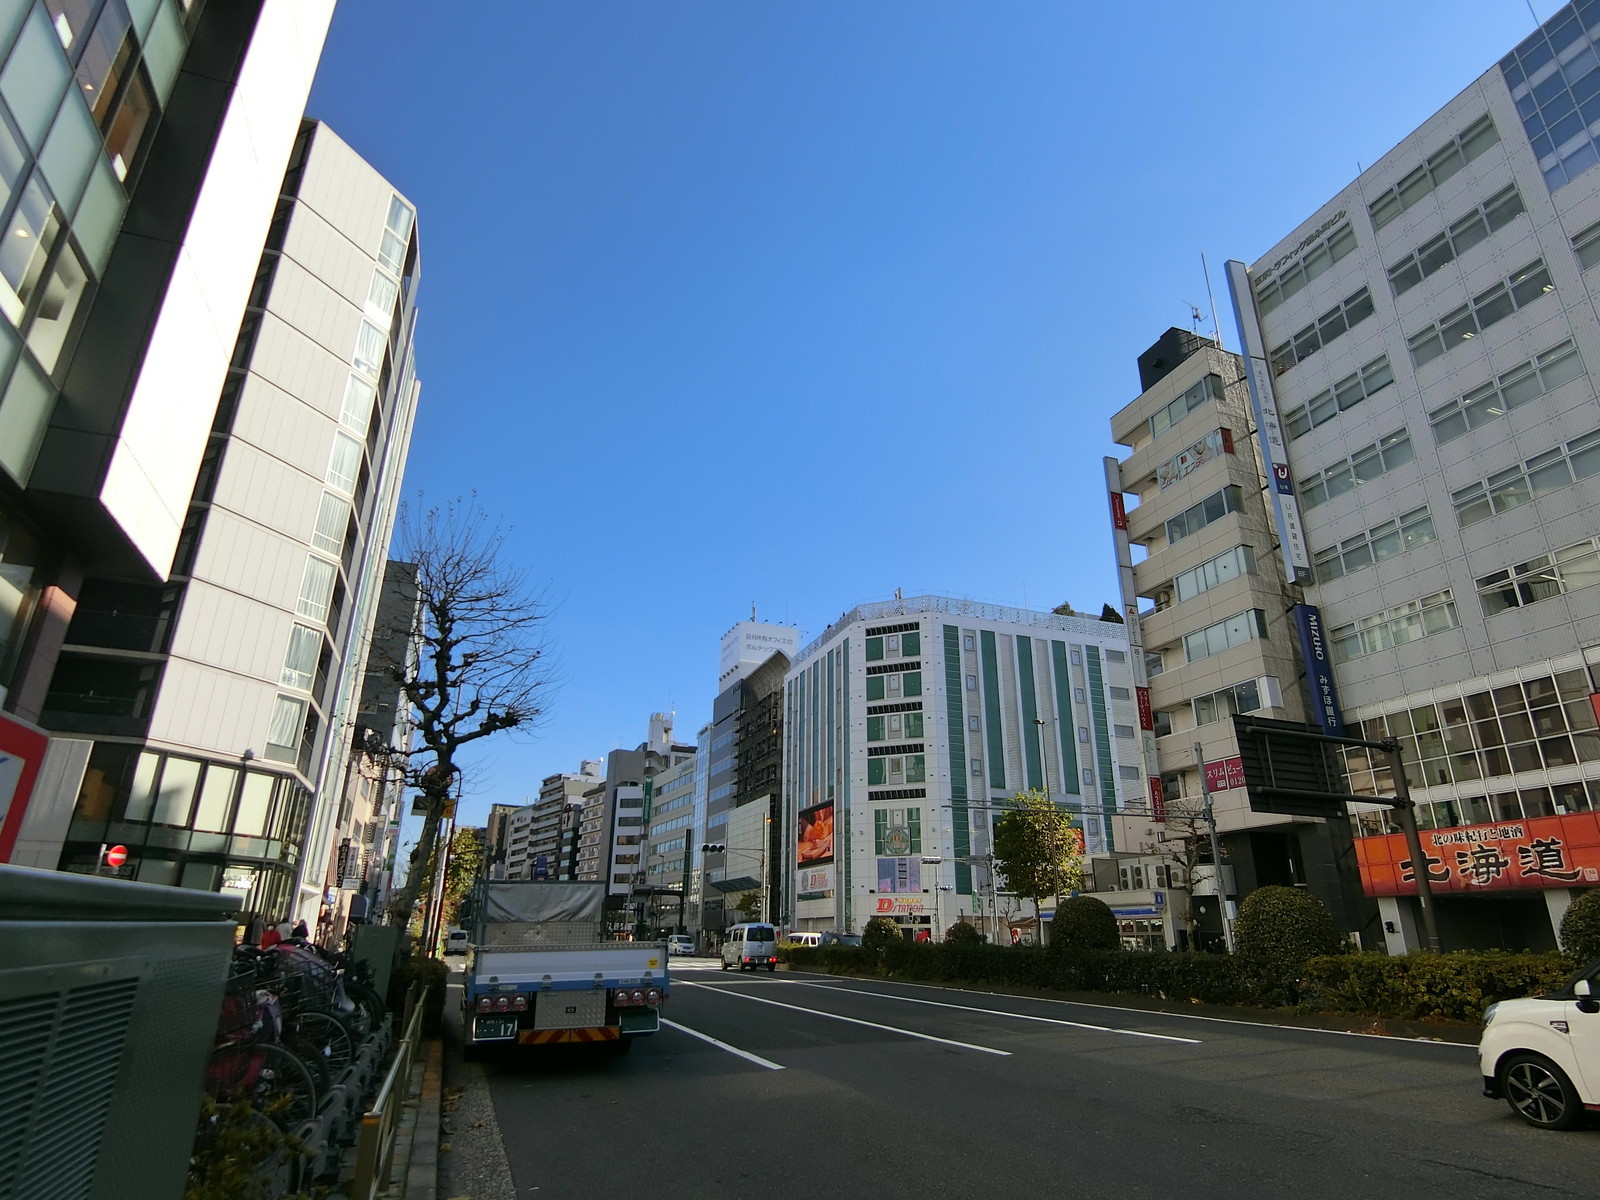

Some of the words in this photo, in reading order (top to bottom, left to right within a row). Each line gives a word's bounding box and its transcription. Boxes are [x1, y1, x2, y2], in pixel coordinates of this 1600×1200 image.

[745, 633, 793, 645] 区分所有オフィスの
[1308, 614, 1324, 660] MIZUHO
[1320, 675, 1336, 727] みずほ銀行
[1206, 767, 1225, 779] スリム
[1432, 825, 1525, 846] 北の味紀行と地酒
